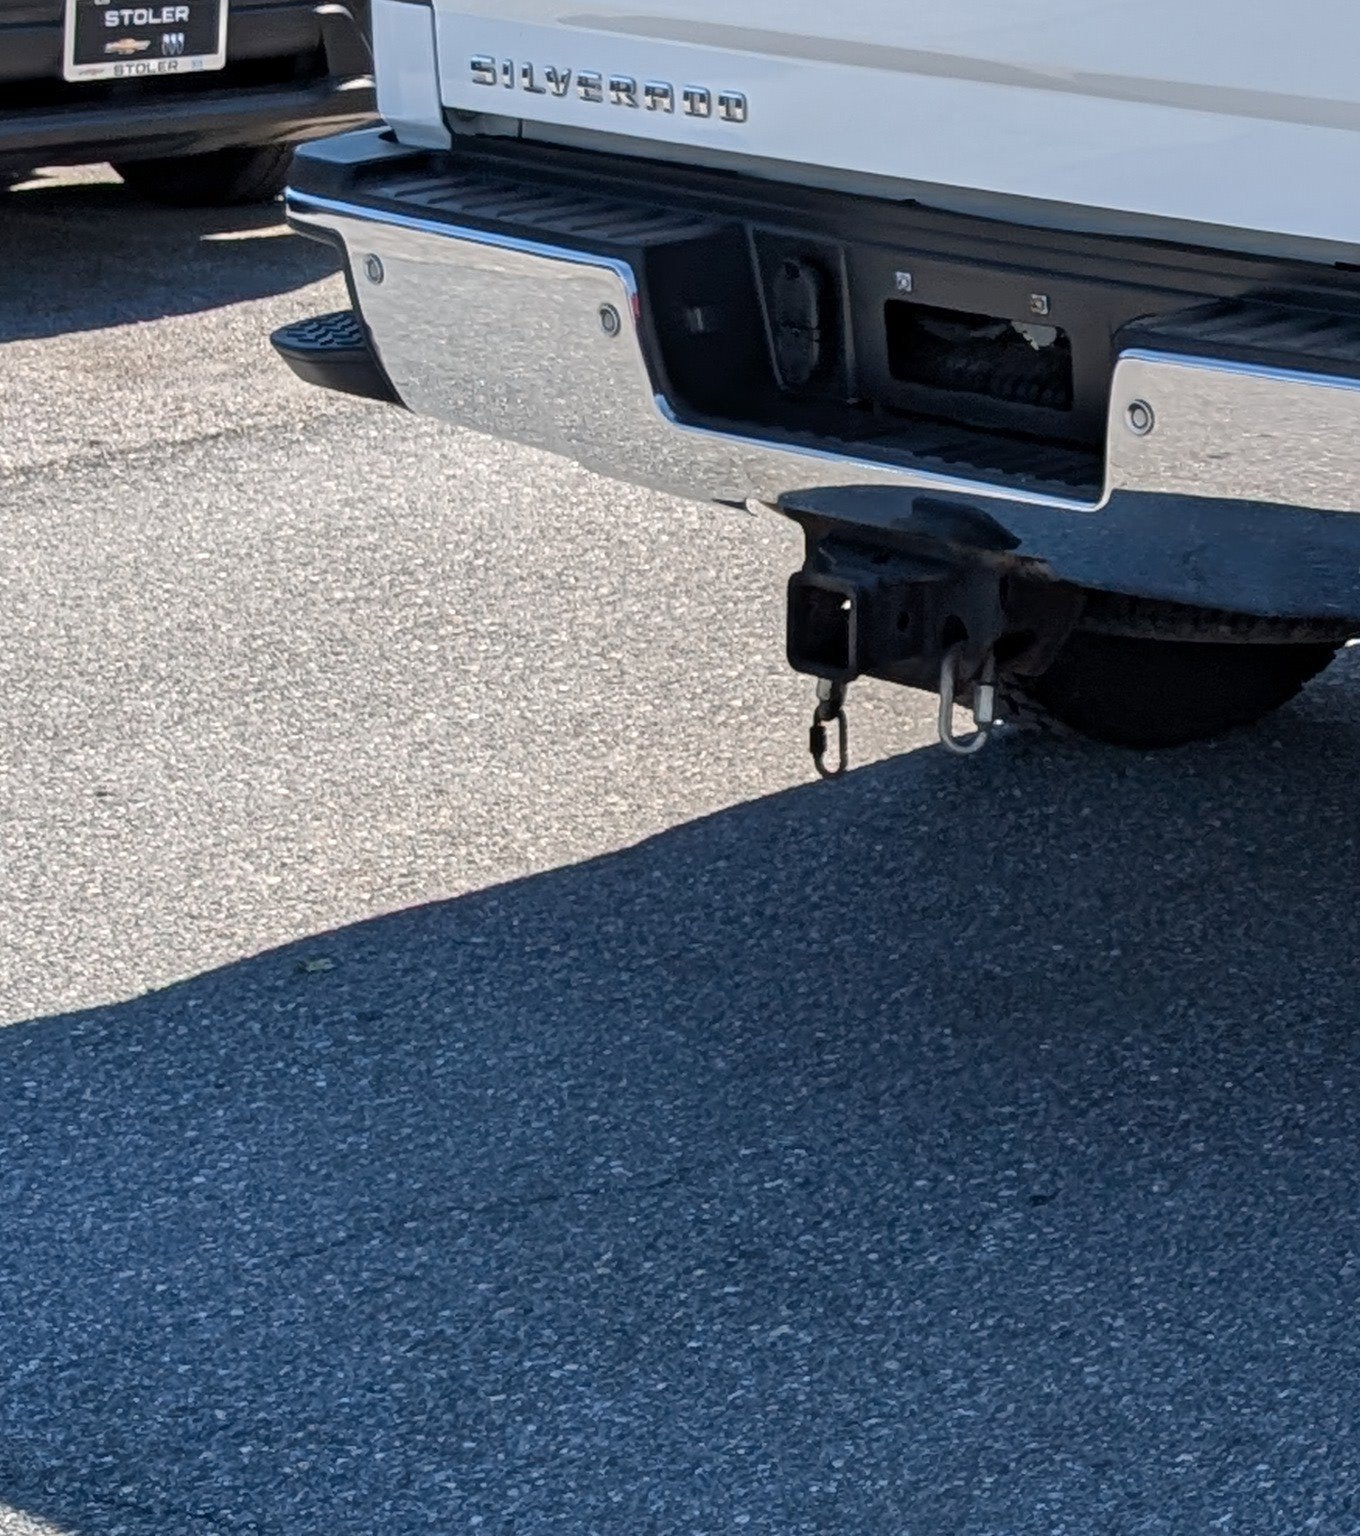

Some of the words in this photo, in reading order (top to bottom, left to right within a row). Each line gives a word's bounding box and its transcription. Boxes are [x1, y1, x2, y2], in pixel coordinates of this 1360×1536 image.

[104, 5, 190, 27] STOLER
[113, 60, 179, 77] STOLER
[469, 54, 748, 124] SILVERADO
